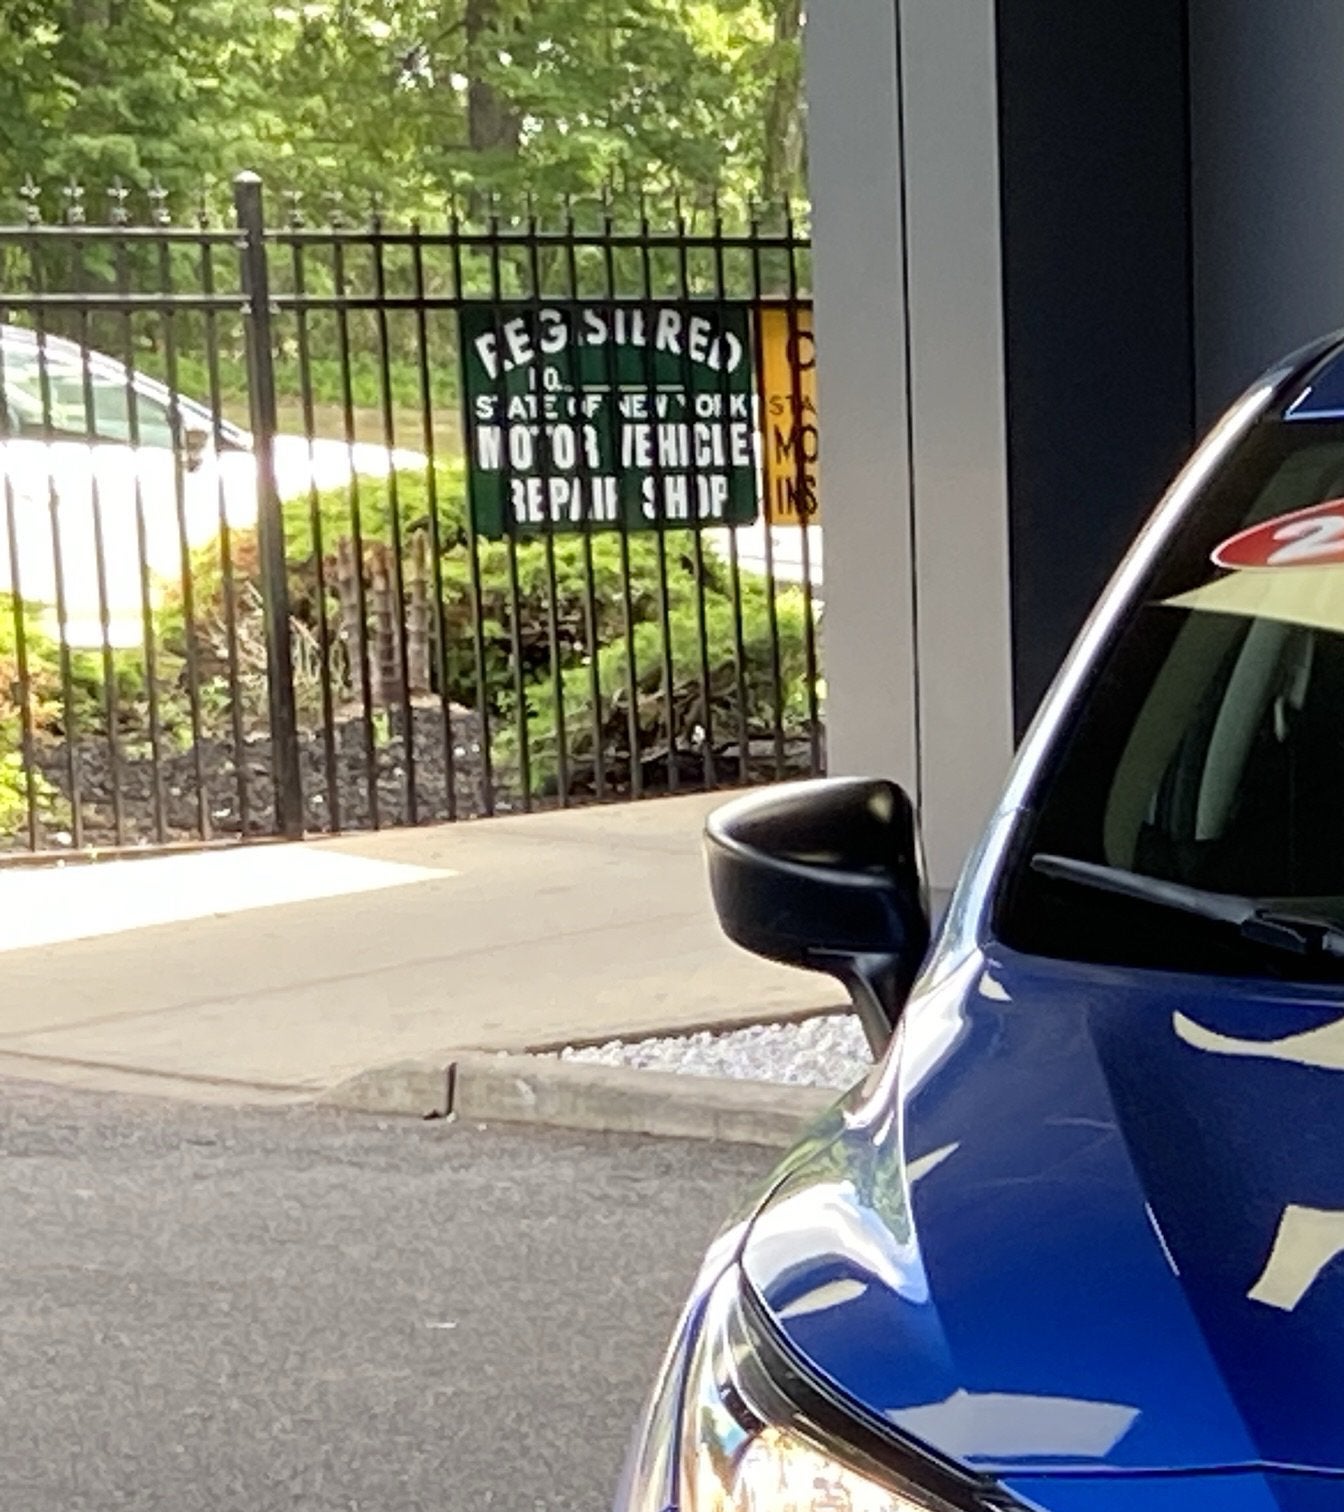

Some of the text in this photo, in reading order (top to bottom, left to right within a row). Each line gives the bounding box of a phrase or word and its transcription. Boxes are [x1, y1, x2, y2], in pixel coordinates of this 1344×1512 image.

[475, 308, 743, 380] REGSTERED
[475, 394, 559, 420] SATE
[676, 394, 748, 418] OK
[477, 423, 601, 471] MOOR
[641, 474, 729, 520] SHOP
